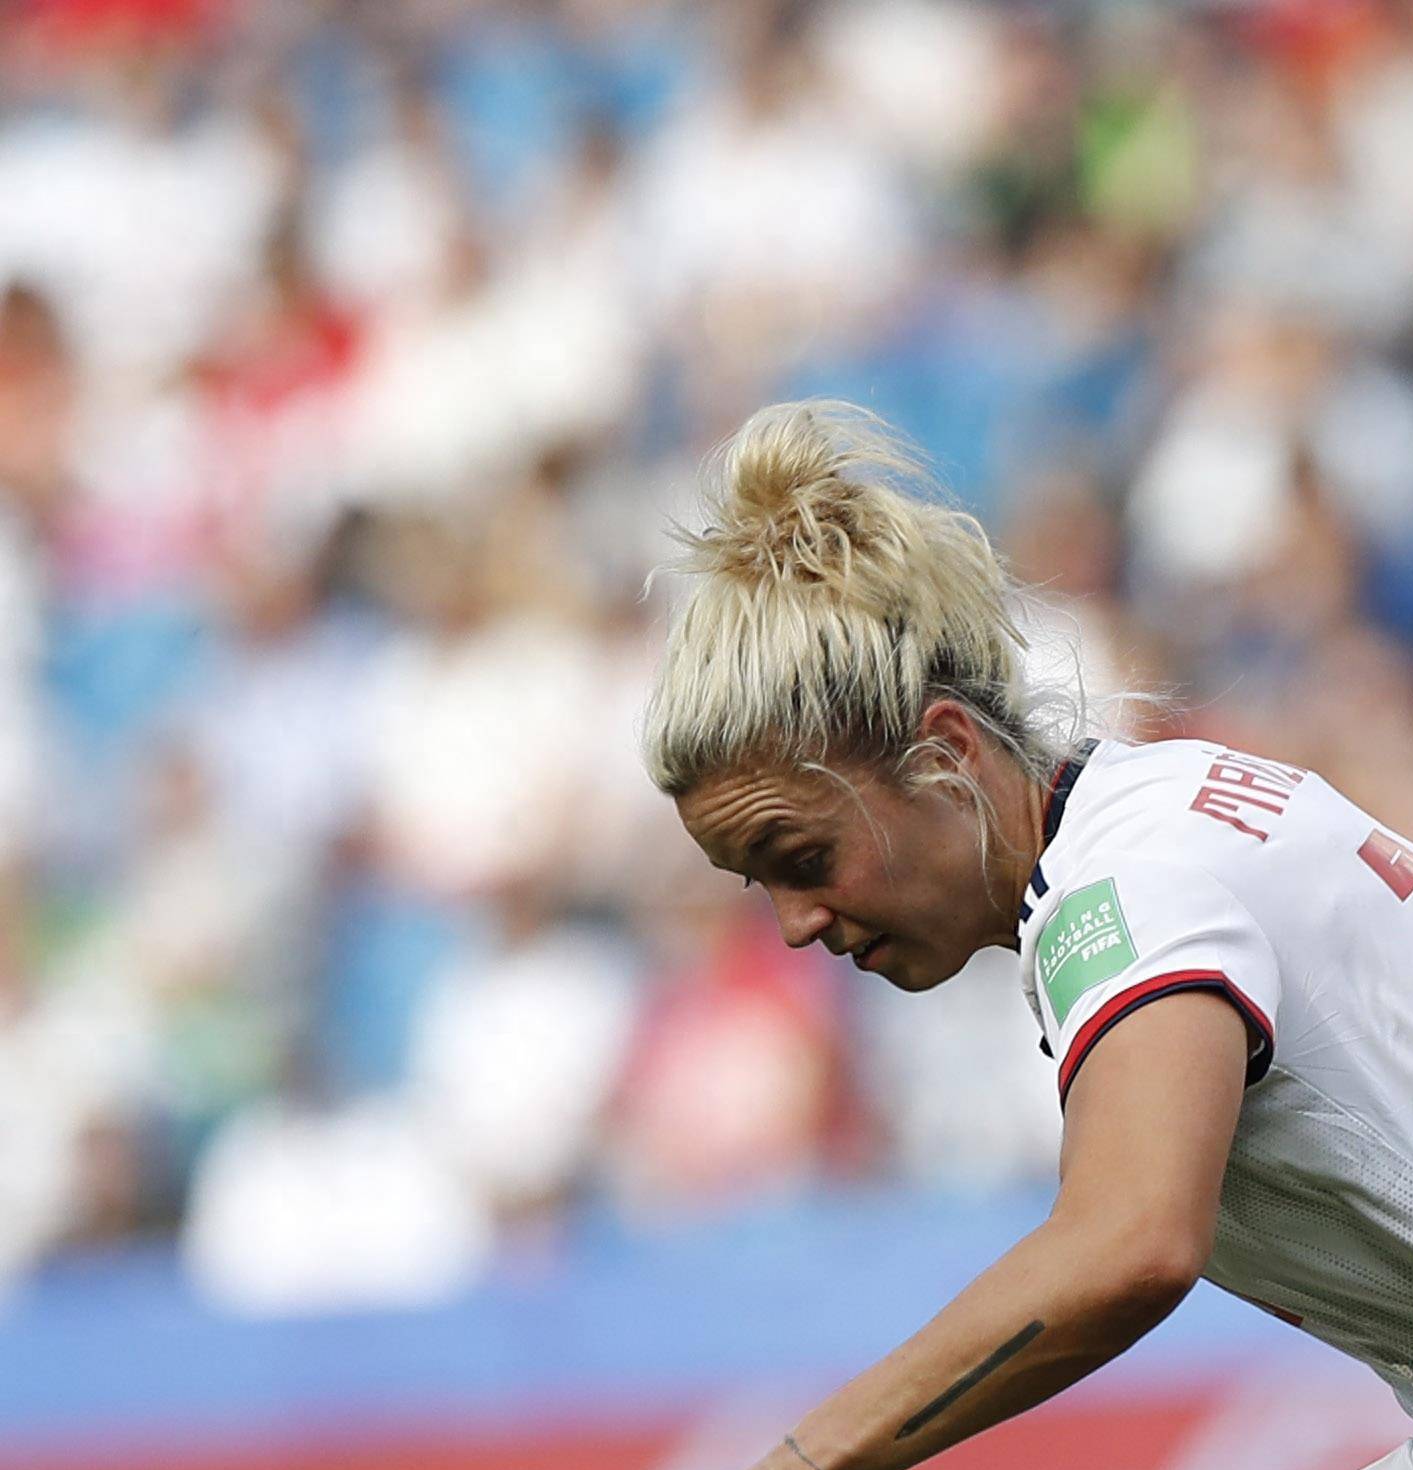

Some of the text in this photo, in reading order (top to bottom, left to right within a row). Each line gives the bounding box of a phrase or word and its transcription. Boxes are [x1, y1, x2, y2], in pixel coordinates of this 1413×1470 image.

[1042, 900, 1112, 968] LIVING
[1044, 912, 1115, 978] FOOTBALL
[1080, 930, 1122, 962] FIFA
